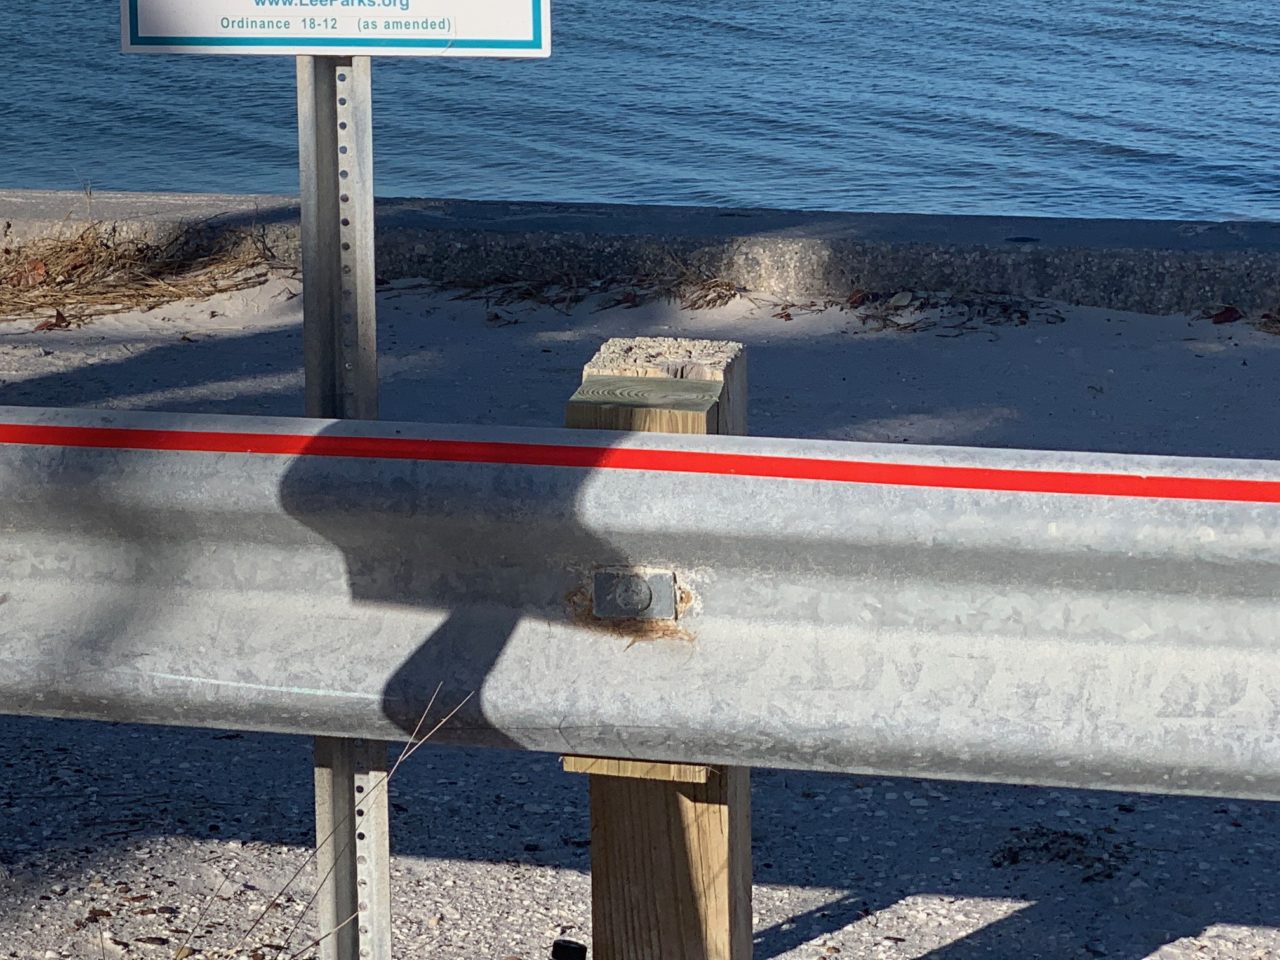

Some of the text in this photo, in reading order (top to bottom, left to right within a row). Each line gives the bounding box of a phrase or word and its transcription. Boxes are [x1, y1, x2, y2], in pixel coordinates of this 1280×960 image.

[220, 17, 451, 32] Ordinance 18-12 (as amended)
